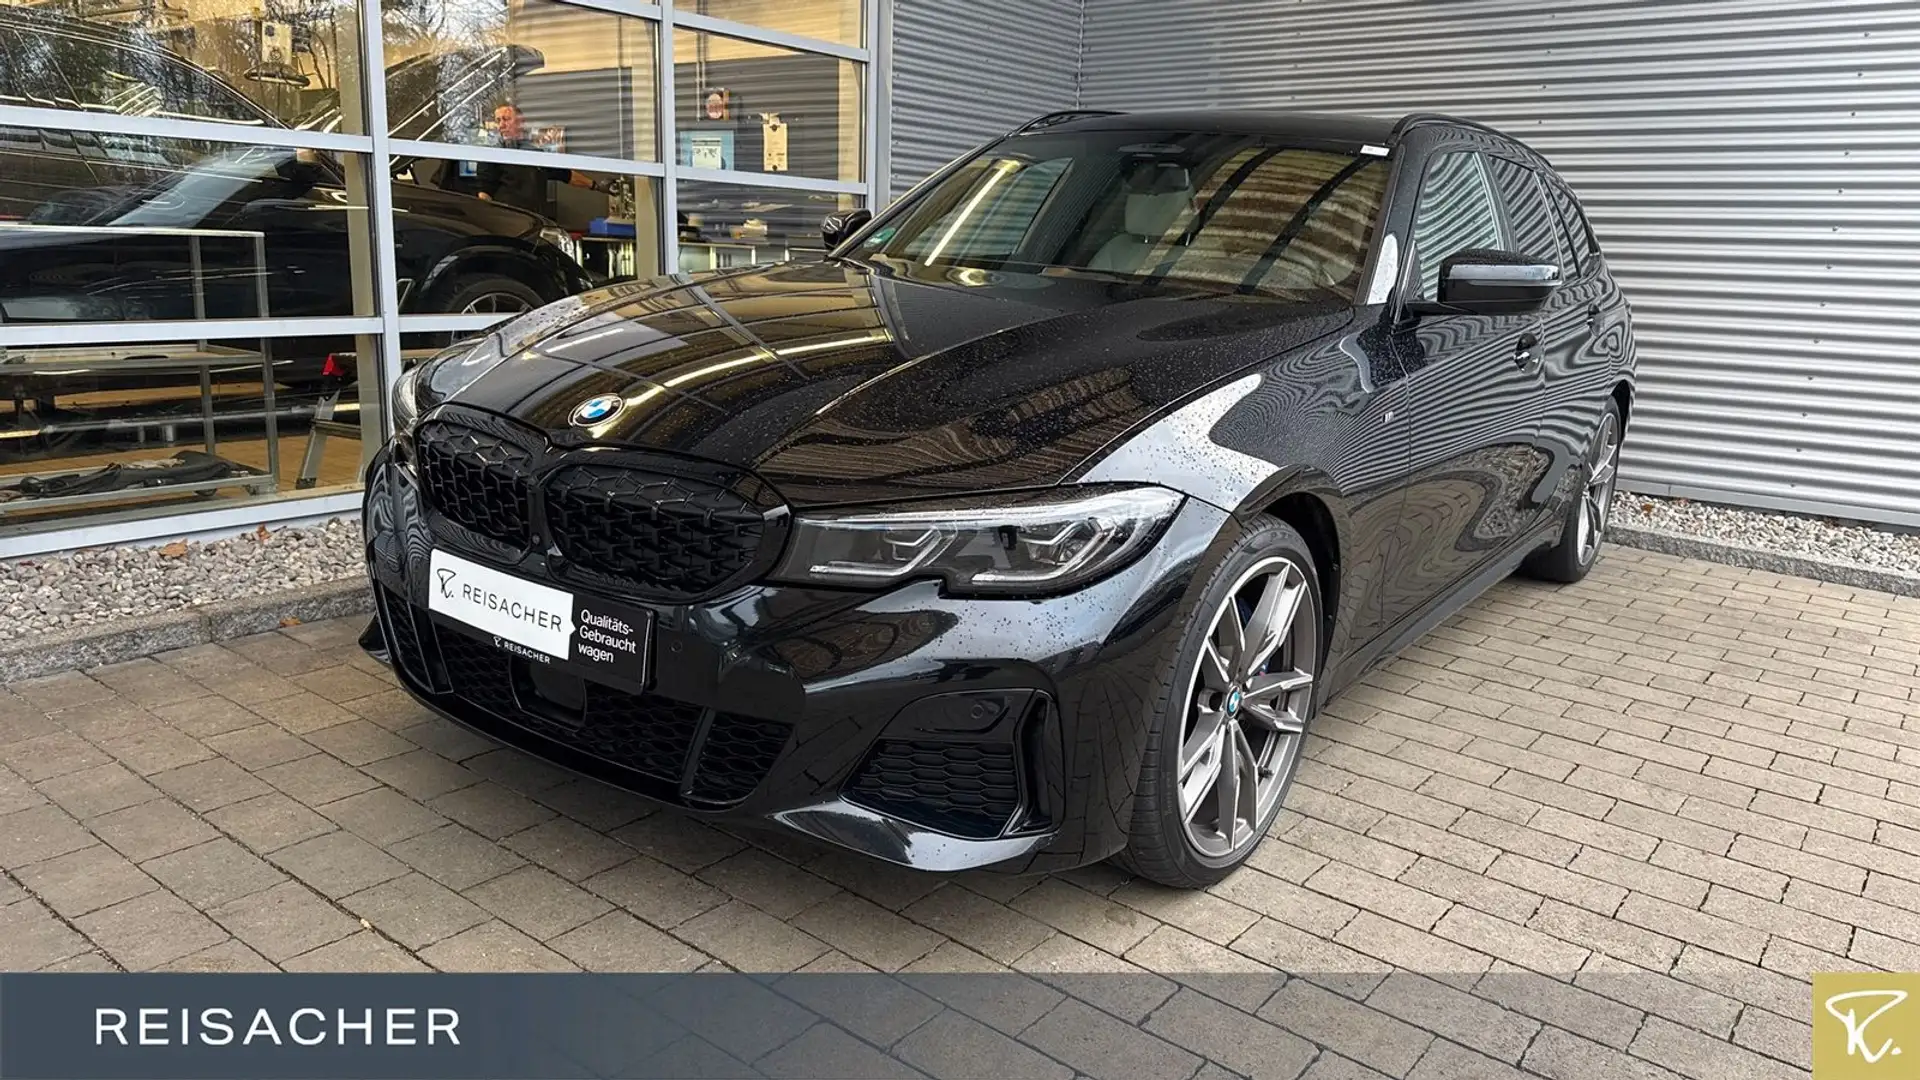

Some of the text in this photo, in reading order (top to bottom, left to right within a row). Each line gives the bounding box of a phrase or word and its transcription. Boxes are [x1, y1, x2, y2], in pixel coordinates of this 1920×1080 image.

[463, 583, 562, 633] REISACHER
[581, 609, 634, 635] Qualitäts-
[504, 641, 551, 665] REISACHER
[578, 643, 614, 663] wagen
[579, 626, 637, 654] Gebraucht
